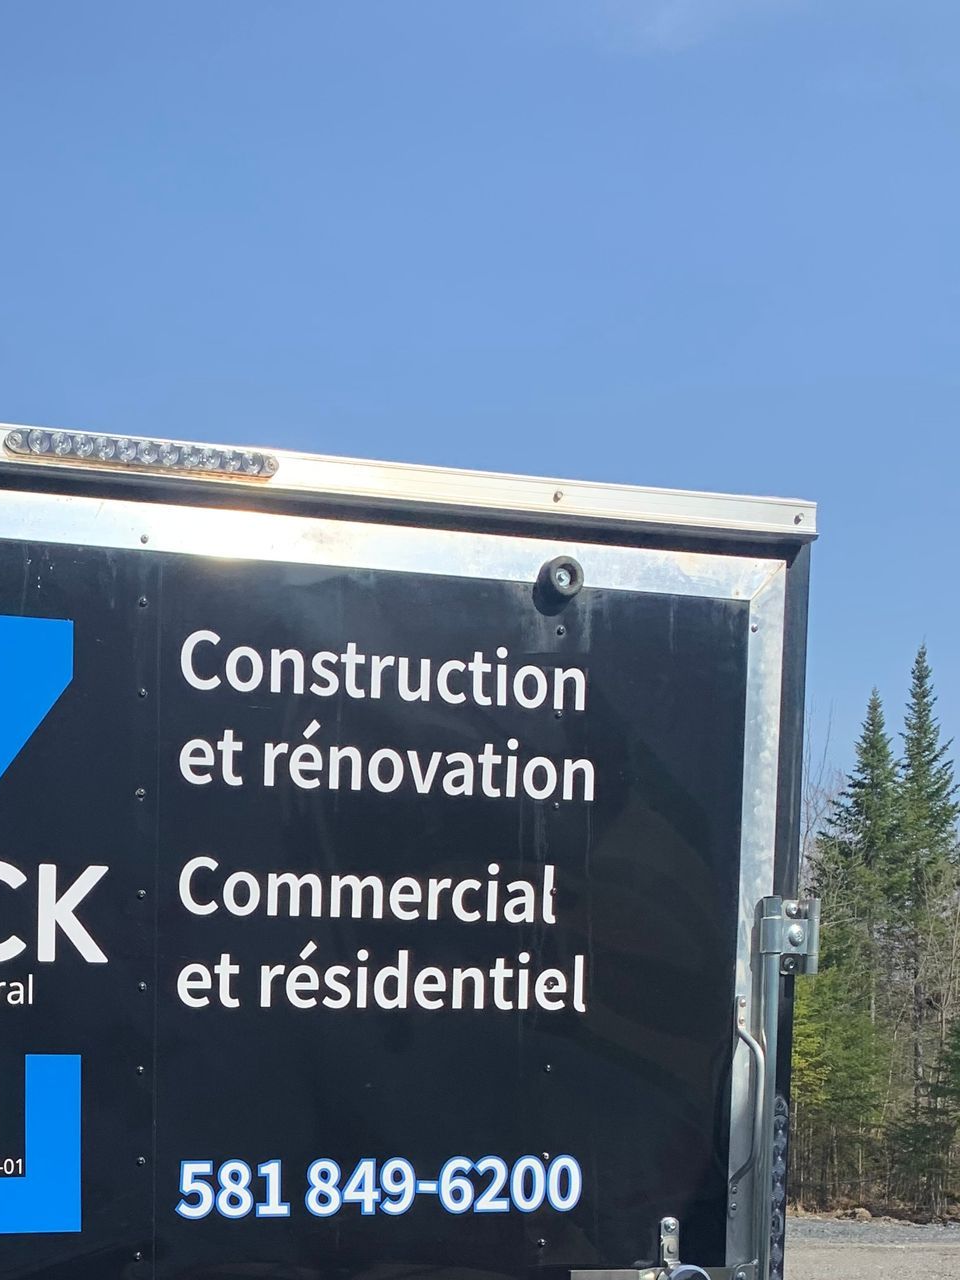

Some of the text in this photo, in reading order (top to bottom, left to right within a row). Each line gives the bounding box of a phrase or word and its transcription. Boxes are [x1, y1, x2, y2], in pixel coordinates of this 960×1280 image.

[180, 629, 587, 711] Construction
[179, 719, 596, 802] et rénovation
[178, 856, 558, 925] Commercial
[176, 940, 587, 1013] et résidentiel
[175, 1154, 583, 1220] 581 849-6200
